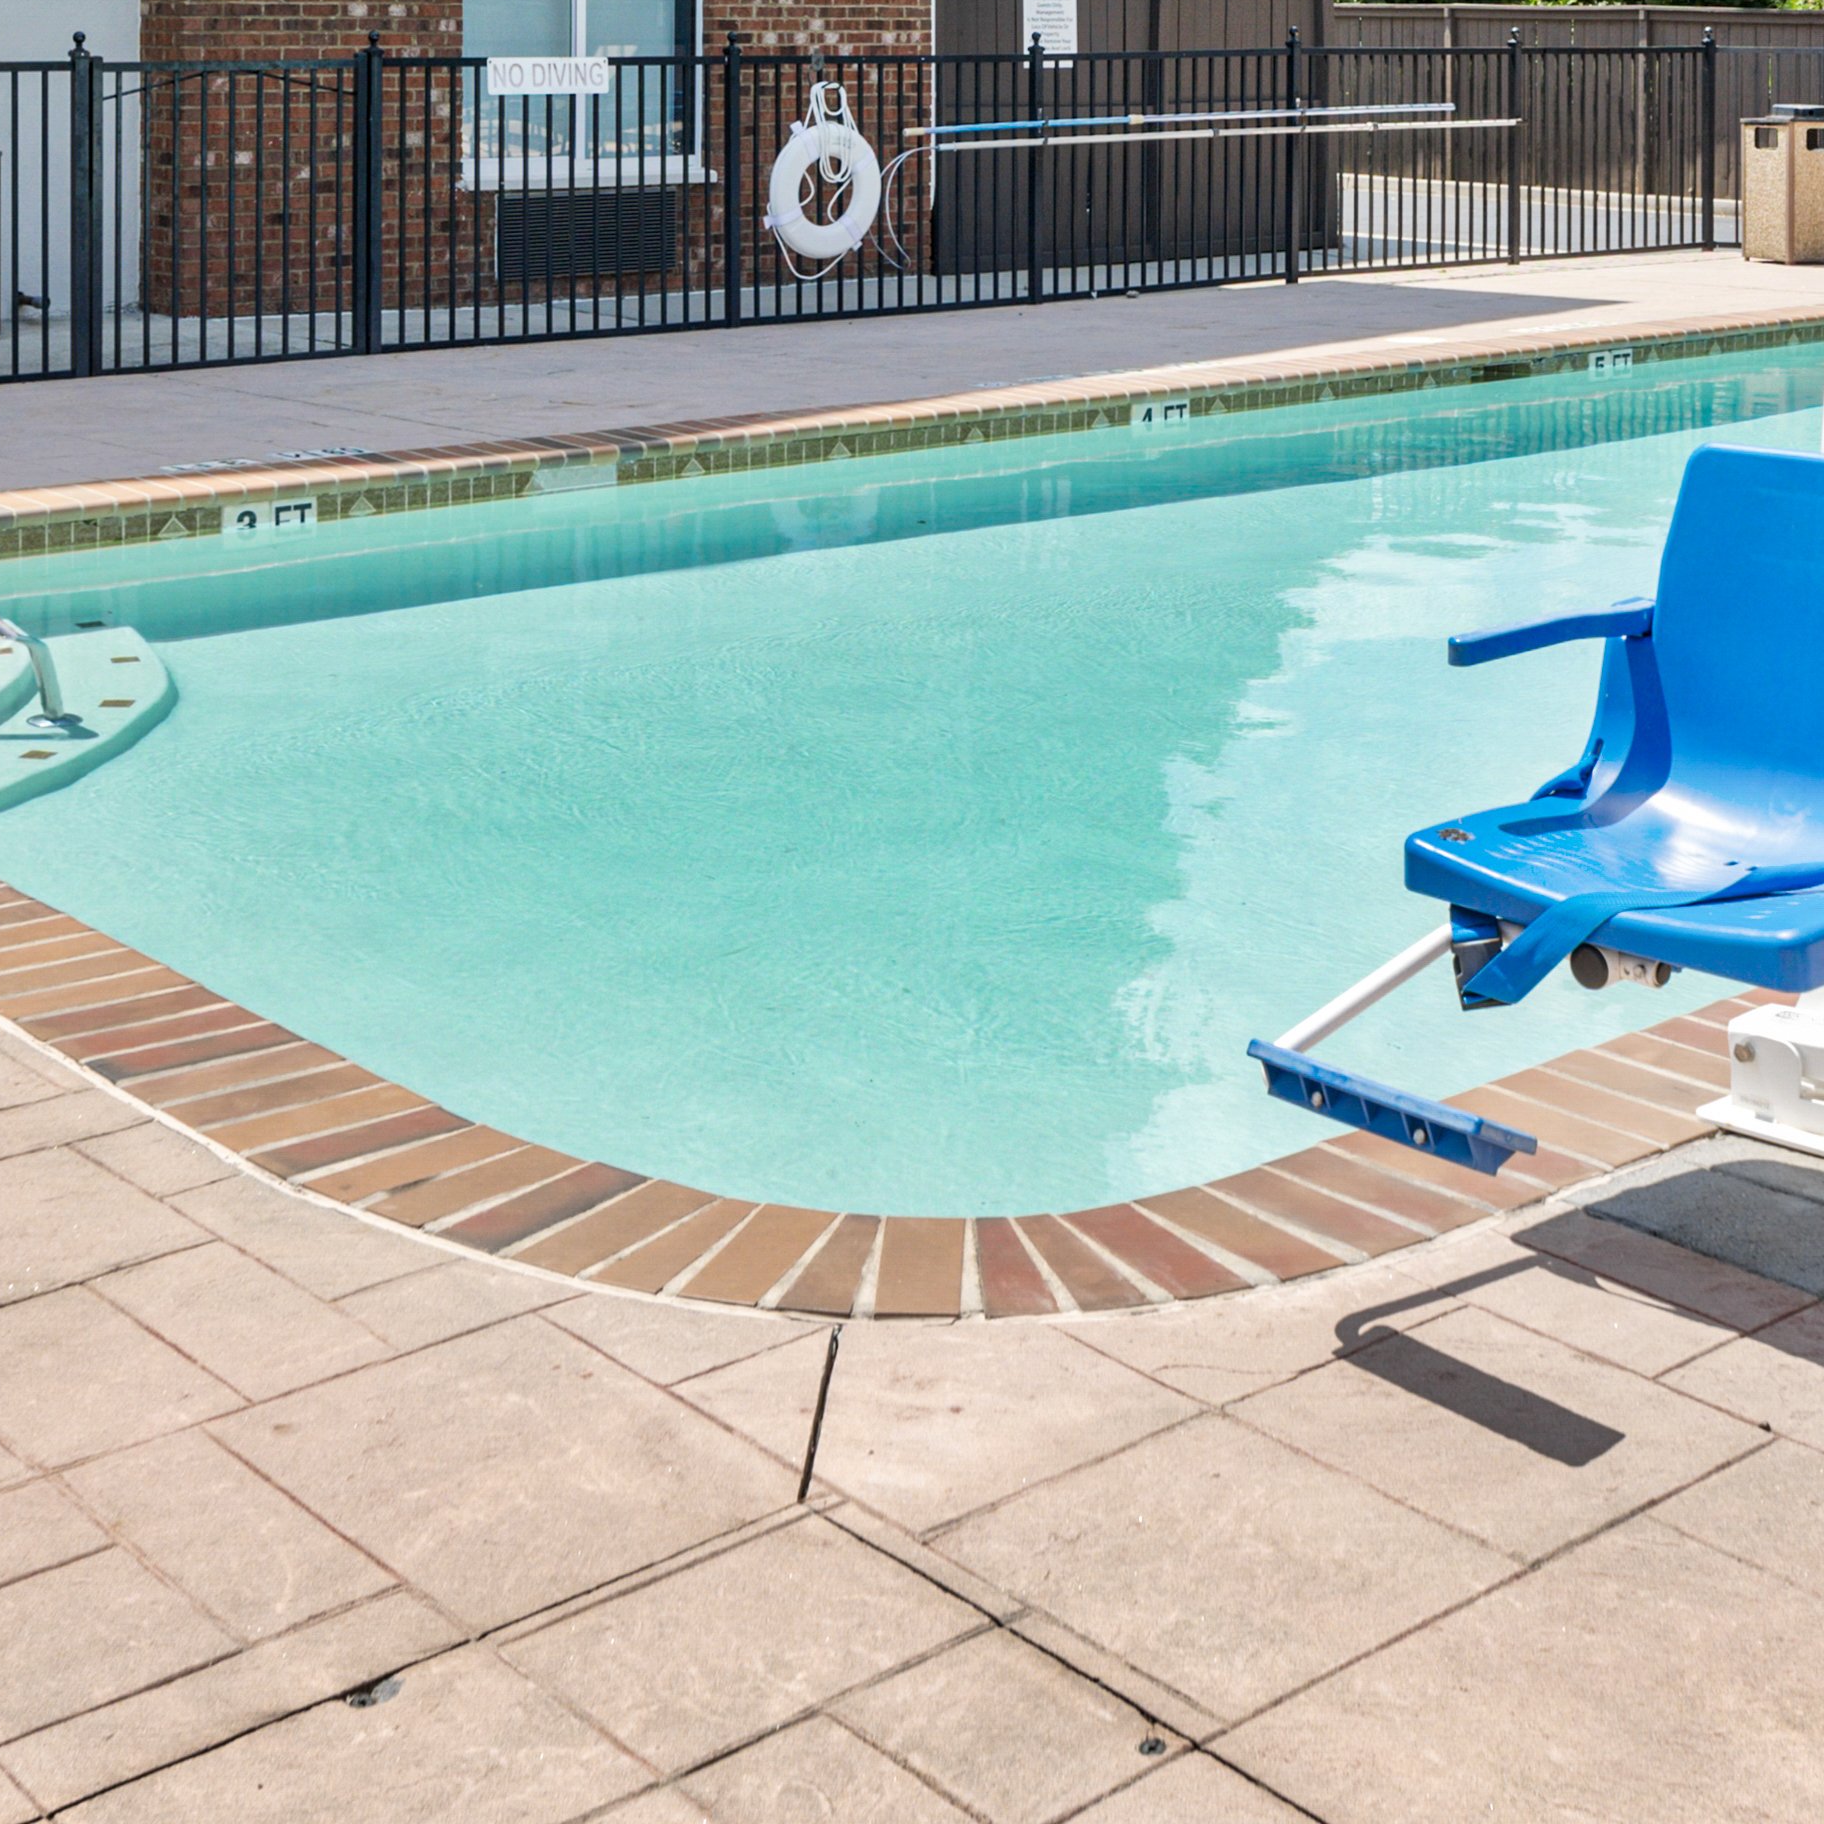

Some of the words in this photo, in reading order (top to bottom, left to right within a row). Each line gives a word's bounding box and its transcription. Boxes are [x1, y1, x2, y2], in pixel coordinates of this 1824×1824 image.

[493, 63, 524, 88] NO
[532, 62, 604, 87] DIVING
[274, 502, 313, 526] FT
